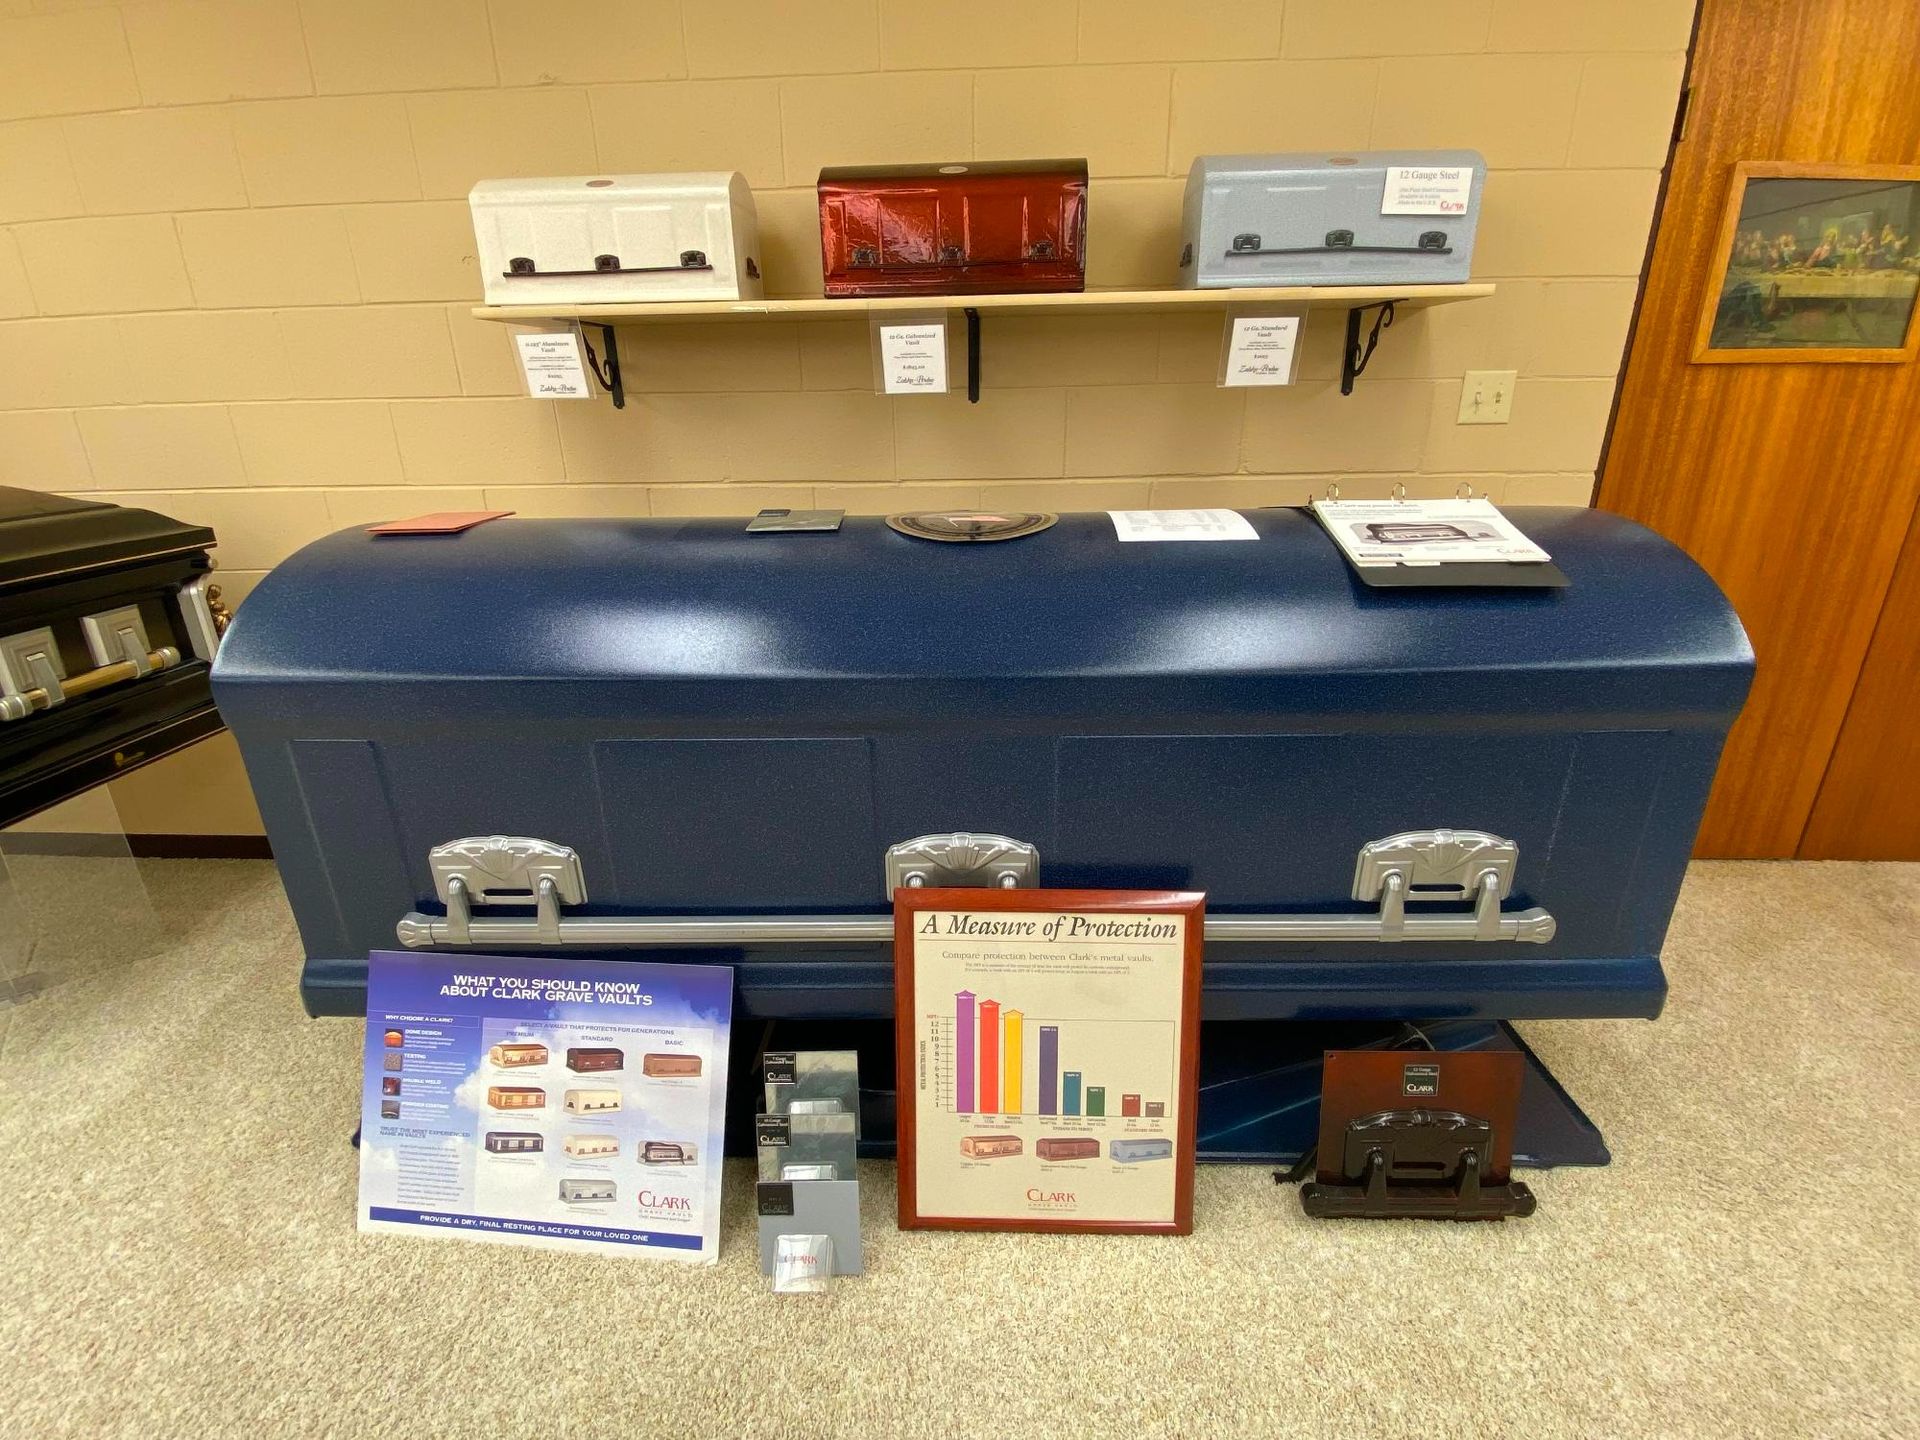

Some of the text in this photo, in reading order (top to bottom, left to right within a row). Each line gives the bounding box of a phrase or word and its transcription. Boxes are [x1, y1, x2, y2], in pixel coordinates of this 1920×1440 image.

[1400, 170, 1459, 181] 12 Gauge Steel
[920, 914, 1177, 942] A Measure of Protection
[942, 950, 980, 961] Compare
[983, 951, 1026, 961] protection
[1029, 951, 1066, 961] between
[1069, 952, 1097, 961] Clark's
[1100, 953, 1124, 962] metal
[453, 975, 640, 994] WHAT YOU SHOULD KNOW
[440, 986, 653, 1006] ABOUT CLARK GRAVE VAULTS
[1407, 1083, 1434, 1092] CLARK
[638, 1190, 691, 1211] CLARK
[1027, 1188, 1076, 1202] CLARK
[420, 1215, 452, 1224] PROVIDE
[479, 1220, 501, 1228] FINAL
[503, 1223, 536, 1231] RESTING
[538, 1226, 562, 1234] PLACE
[604, 1231, 630, 1240] LOVED
[632, 1234, 649, 1242] ONE
